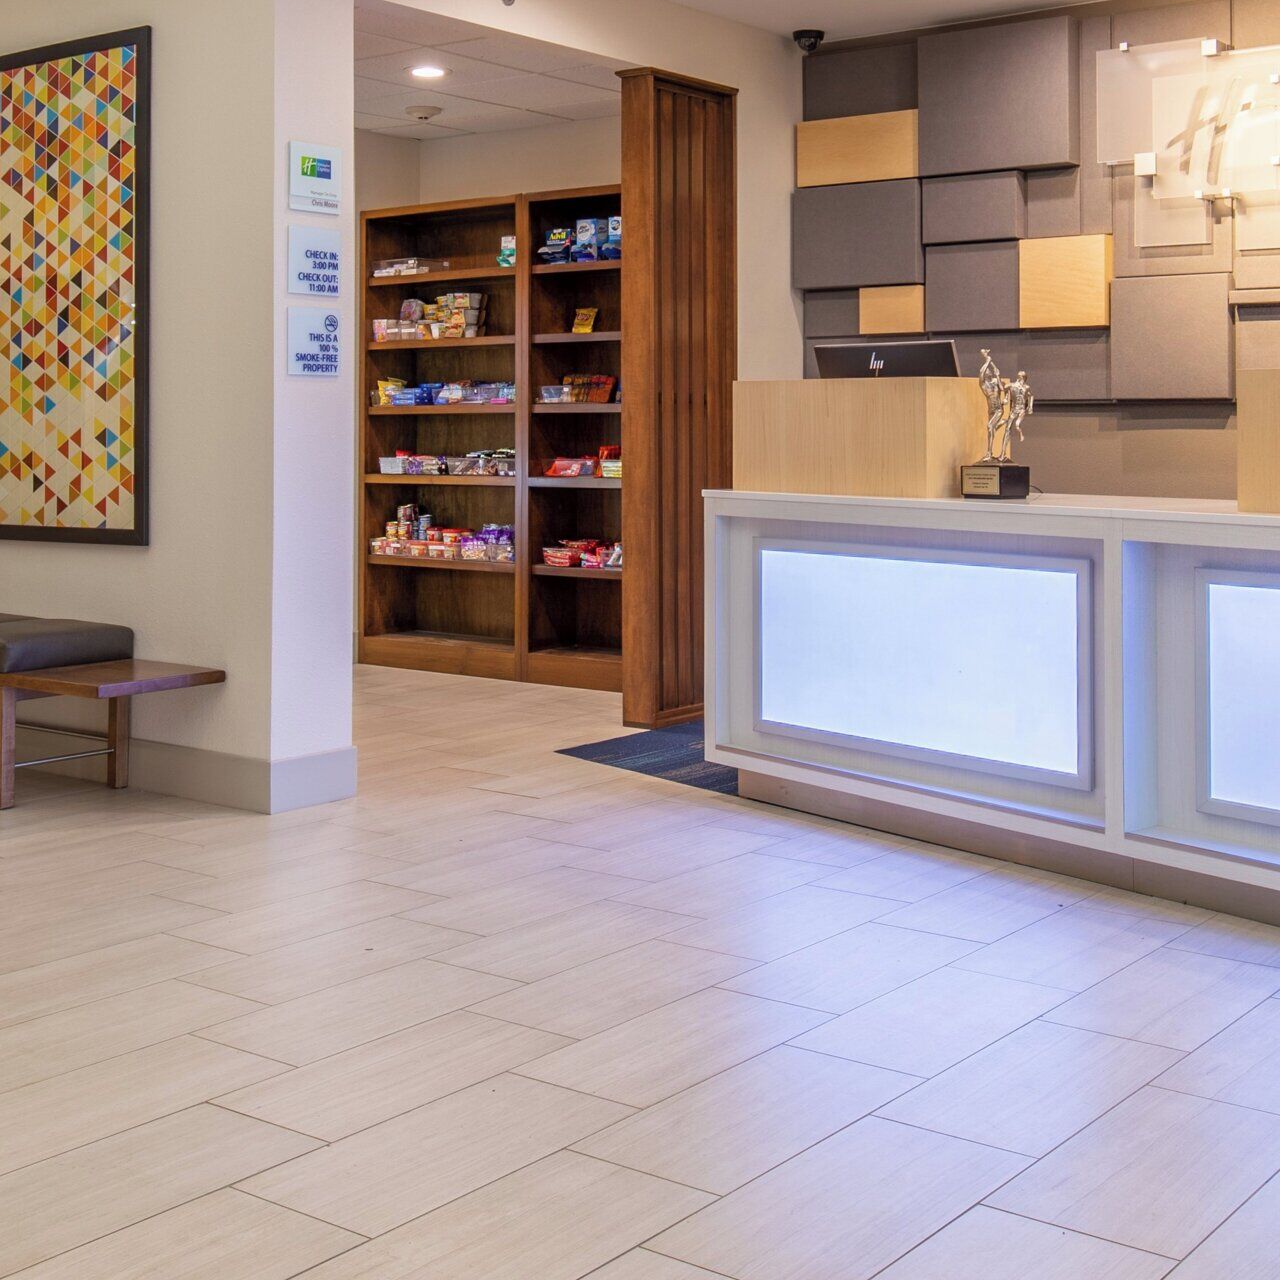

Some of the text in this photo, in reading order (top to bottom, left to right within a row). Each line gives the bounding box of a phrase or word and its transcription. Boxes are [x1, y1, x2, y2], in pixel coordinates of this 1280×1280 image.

[305, 249, 339, 261] CHECK IN:
[312, 261, 338, 271] 3:00 PM
[298, 272, 339, 284] CHECK OUT:
[309, 283, 338, 294] 11:00 AM
[309, 333, 338, 343] THIS IS A
[319, 344, 339, 353] 100 %
[295, 352, 339, 363] SMOKE-FREE
[302, 363, 338, 373] PROPERTY
